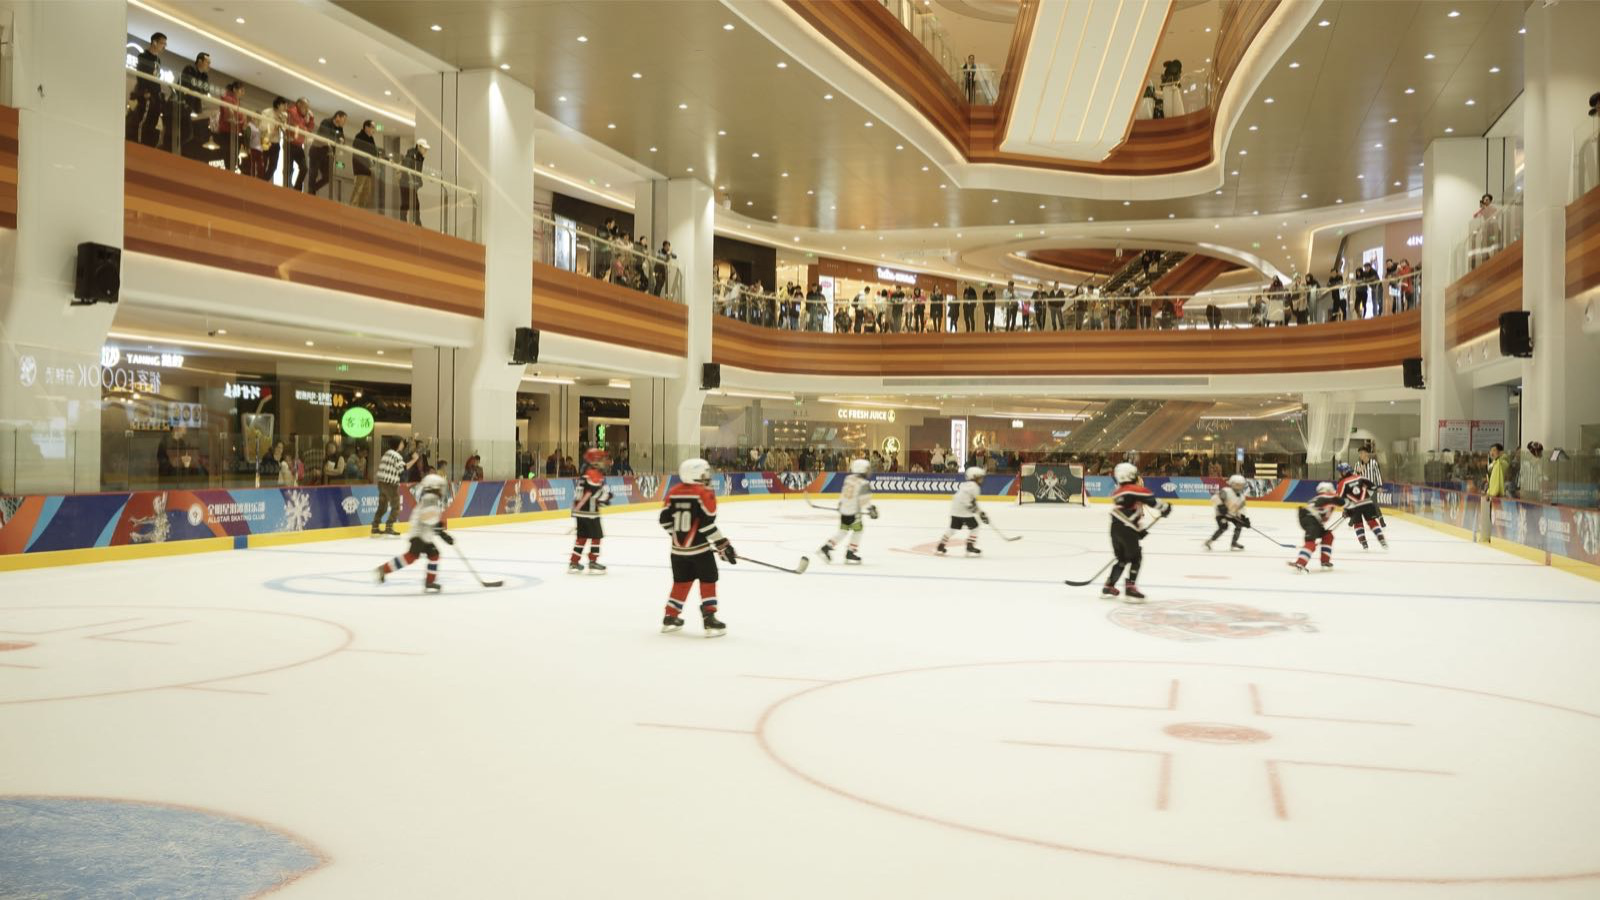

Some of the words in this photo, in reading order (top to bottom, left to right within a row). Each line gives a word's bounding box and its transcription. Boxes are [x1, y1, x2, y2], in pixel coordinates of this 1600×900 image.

[838, 409, 847, 419] CC
[849, 409, 869, 420] FRESH
[870, 410, 887, 421] JUICE
[208, 515, 230, 523] ALLSTAR
[231, 514, 252, 522] SKATING
[672, 511, 691, 532] 10
